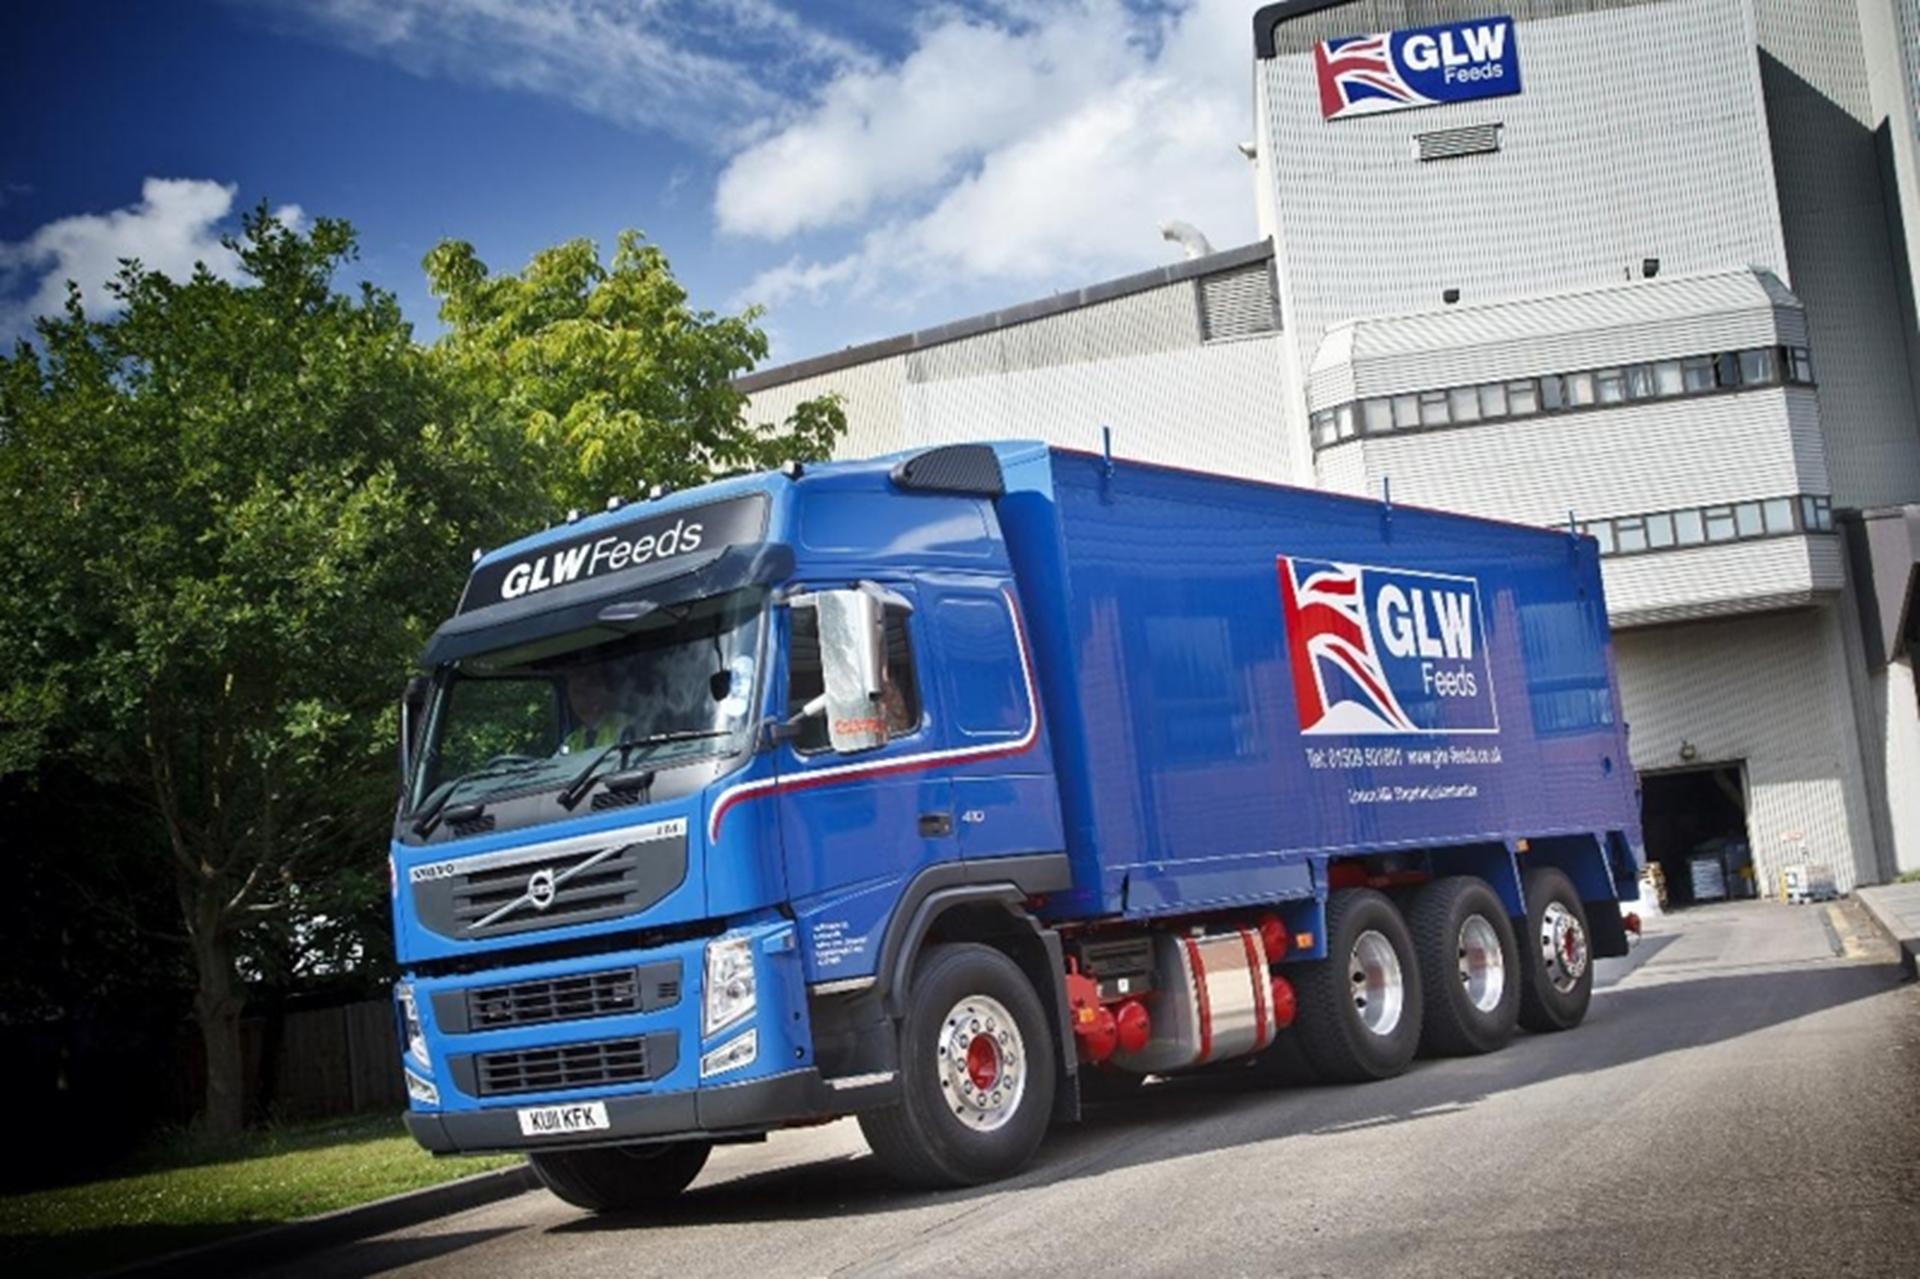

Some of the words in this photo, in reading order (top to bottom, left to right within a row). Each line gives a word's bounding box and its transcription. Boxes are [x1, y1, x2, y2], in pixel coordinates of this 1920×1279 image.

[1402, 23, 1507, 71] GLW
[1444, 62, 1504, 85] Feeds
[501, 543, 592, 600] GLW
[586, 518, 704, 577] Feeds
[1376, 583, 1473, 660] GLW
[1421, 662, 1478, 697] Feeds
[961, 809, 985, 823] 410
[413, 862, 455, 880] VOLVO
[562, 1106, 597, 1129] KFK
